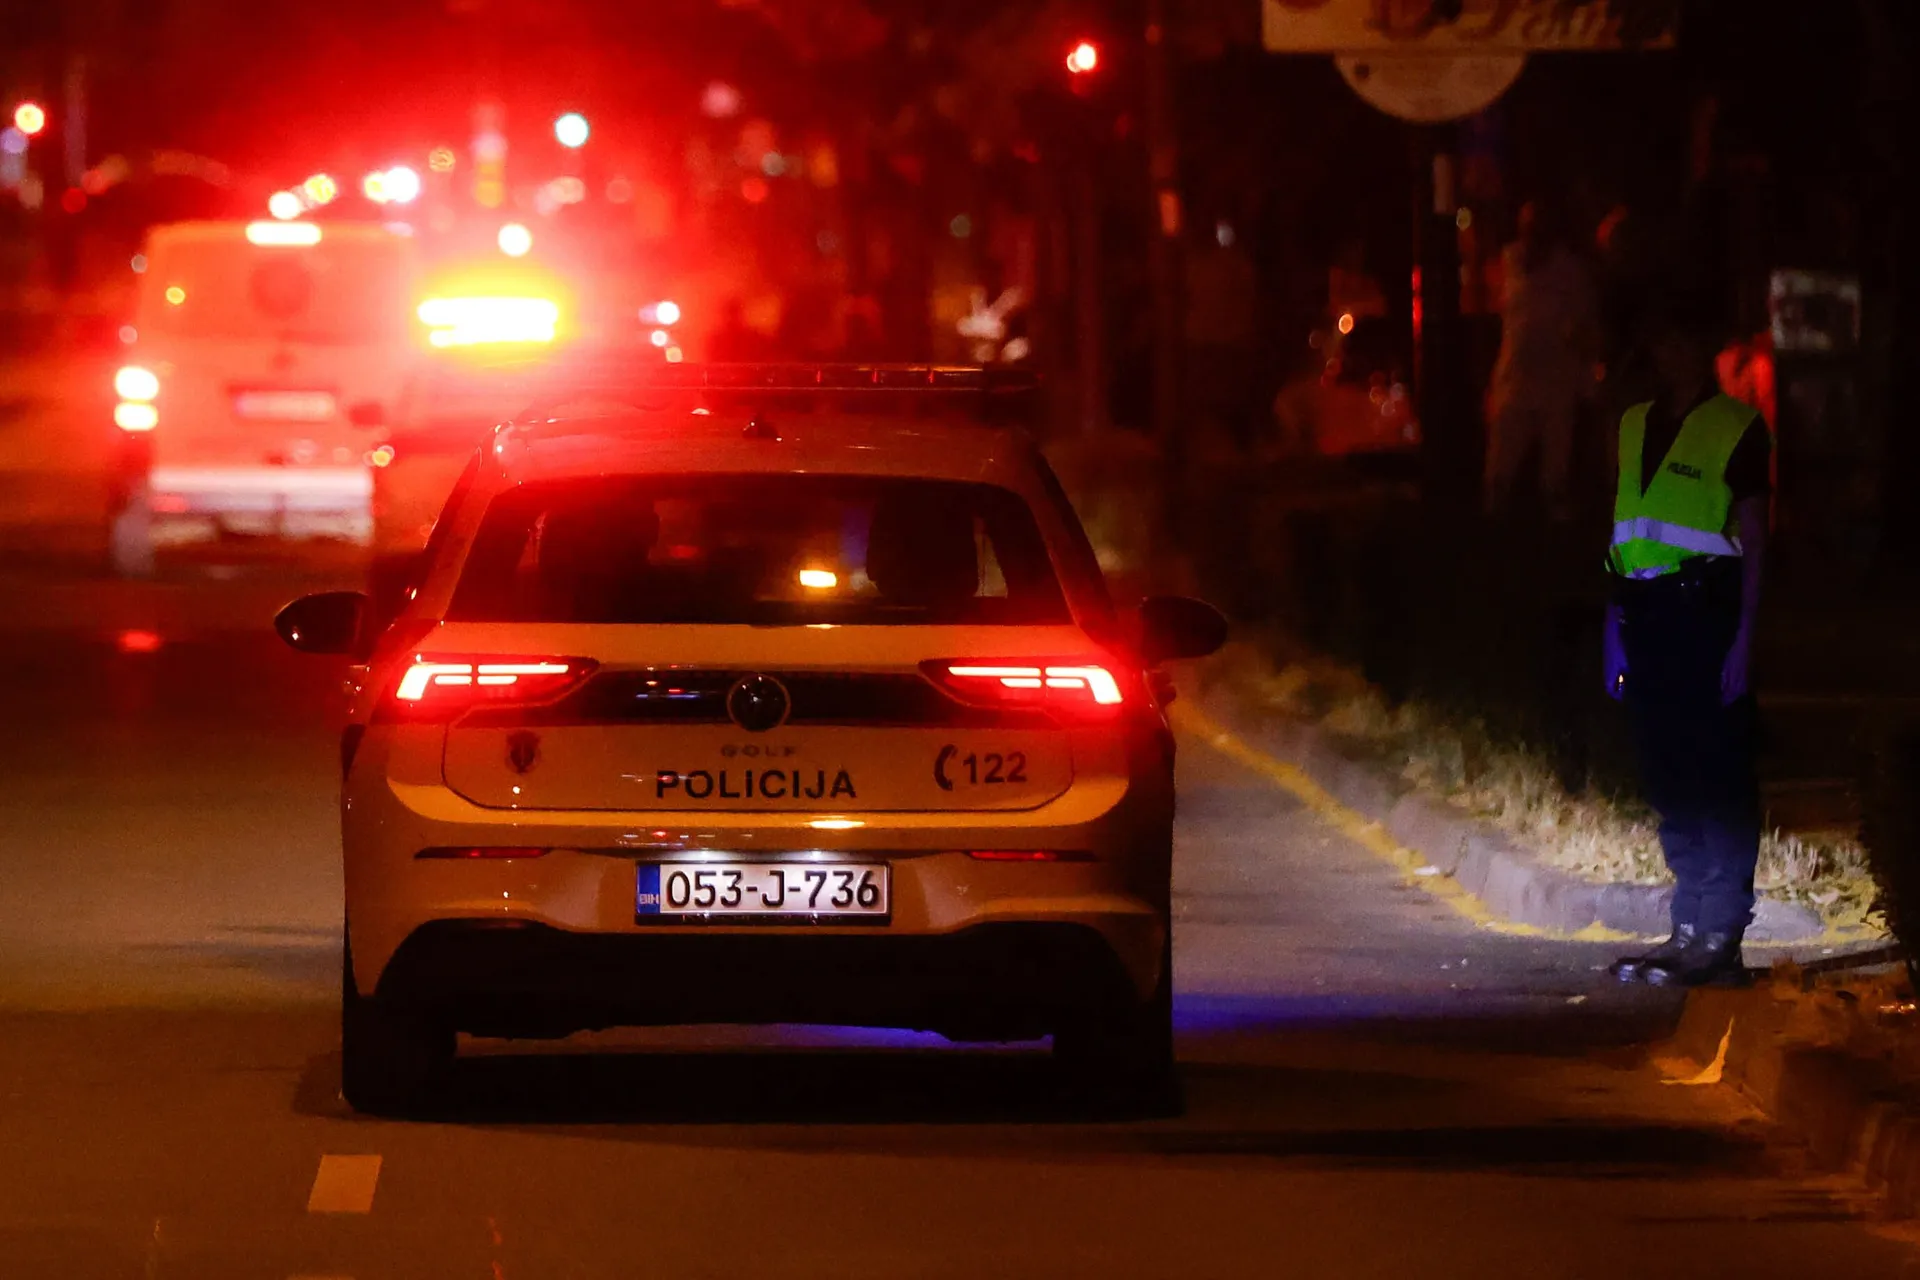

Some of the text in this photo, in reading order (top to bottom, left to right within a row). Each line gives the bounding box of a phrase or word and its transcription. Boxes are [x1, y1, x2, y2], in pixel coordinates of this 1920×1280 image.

[720, 743, 796, 758] GOLF
[963, 751, 1028, 785] 122
[656, 769, 857, 799] POLICIJA
[639, 893, 660, 905] BIH
[667, 870, 880, 908] 053-J-736
